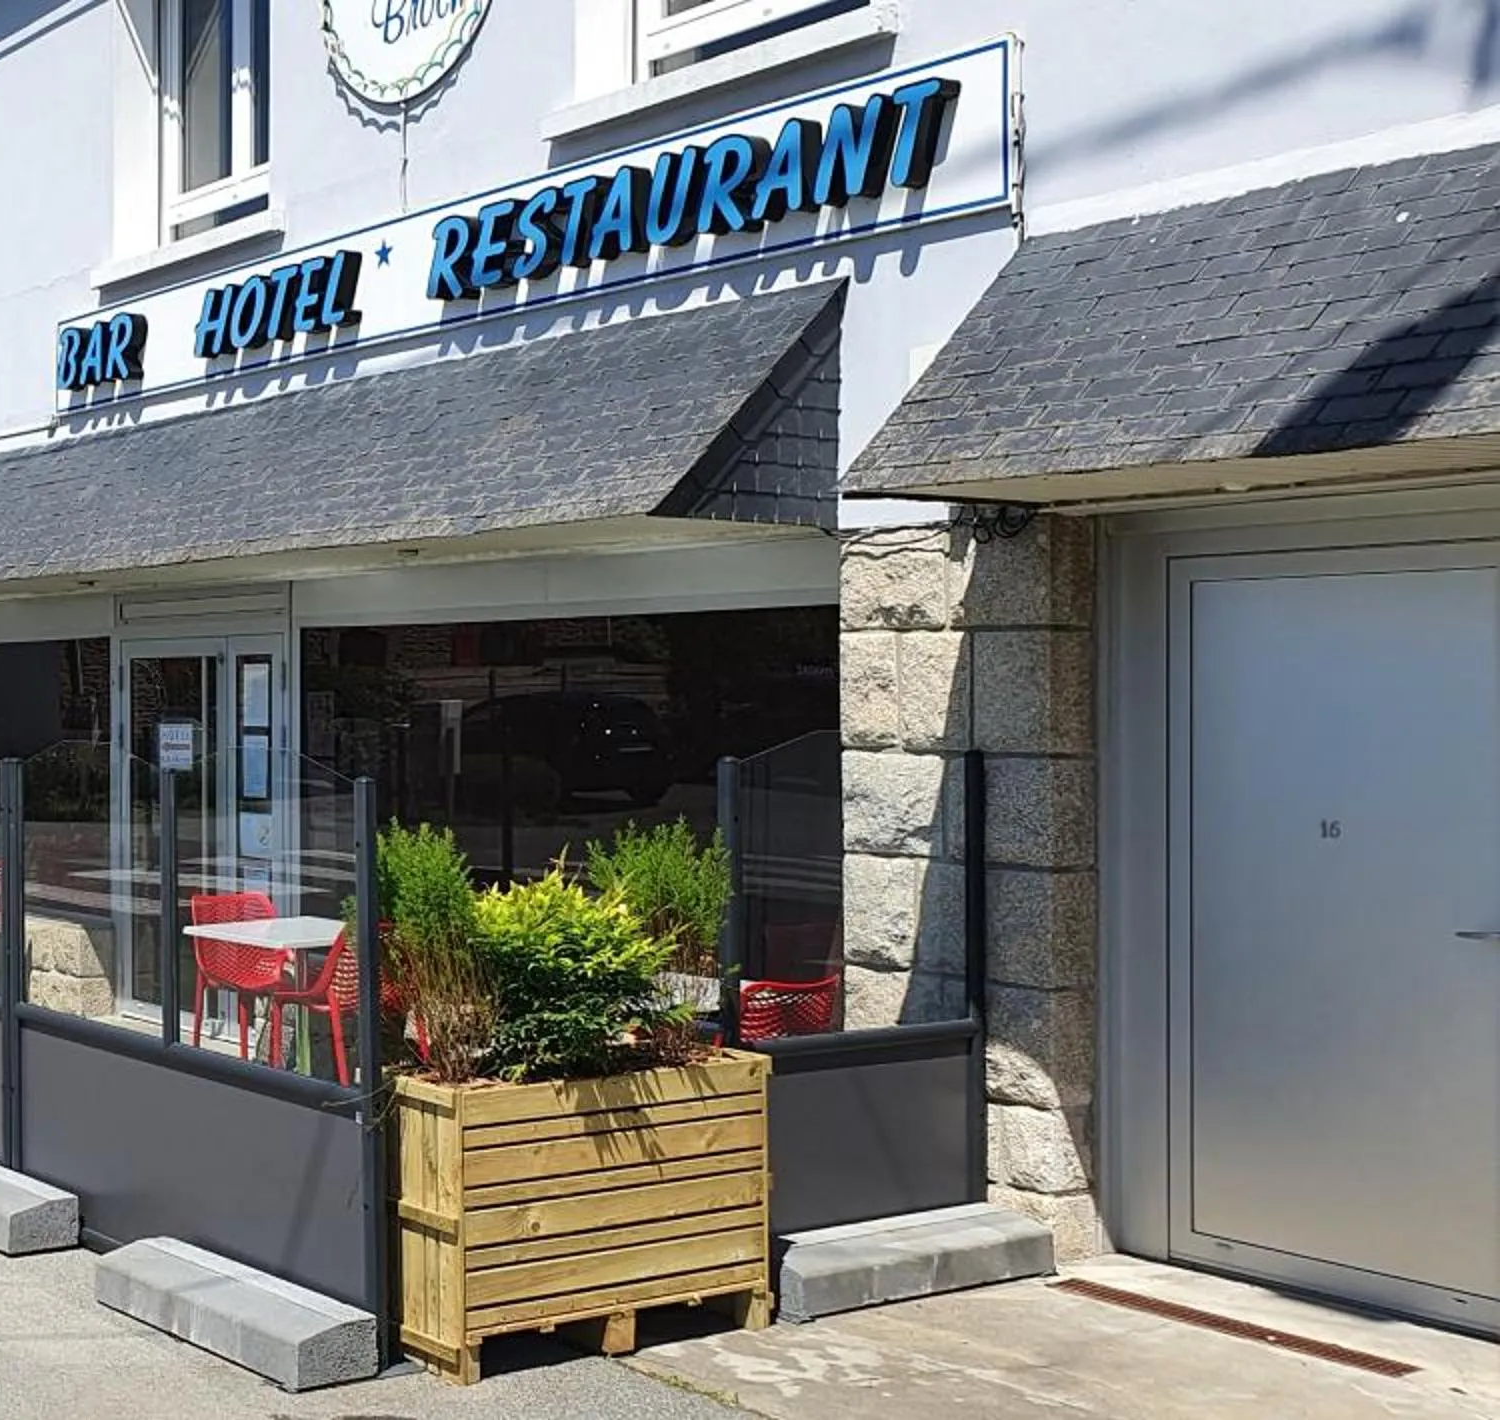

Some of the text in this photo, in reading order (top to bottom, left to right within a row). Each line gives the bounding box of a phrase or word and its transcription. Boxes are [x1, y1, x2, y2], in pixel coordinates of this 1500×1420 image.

[372, 0, 463, 44] Broc
[56, 77, 952, 390] BAR HOTEL RESTAURANT
[1320, 819, 1342, 839] 16
